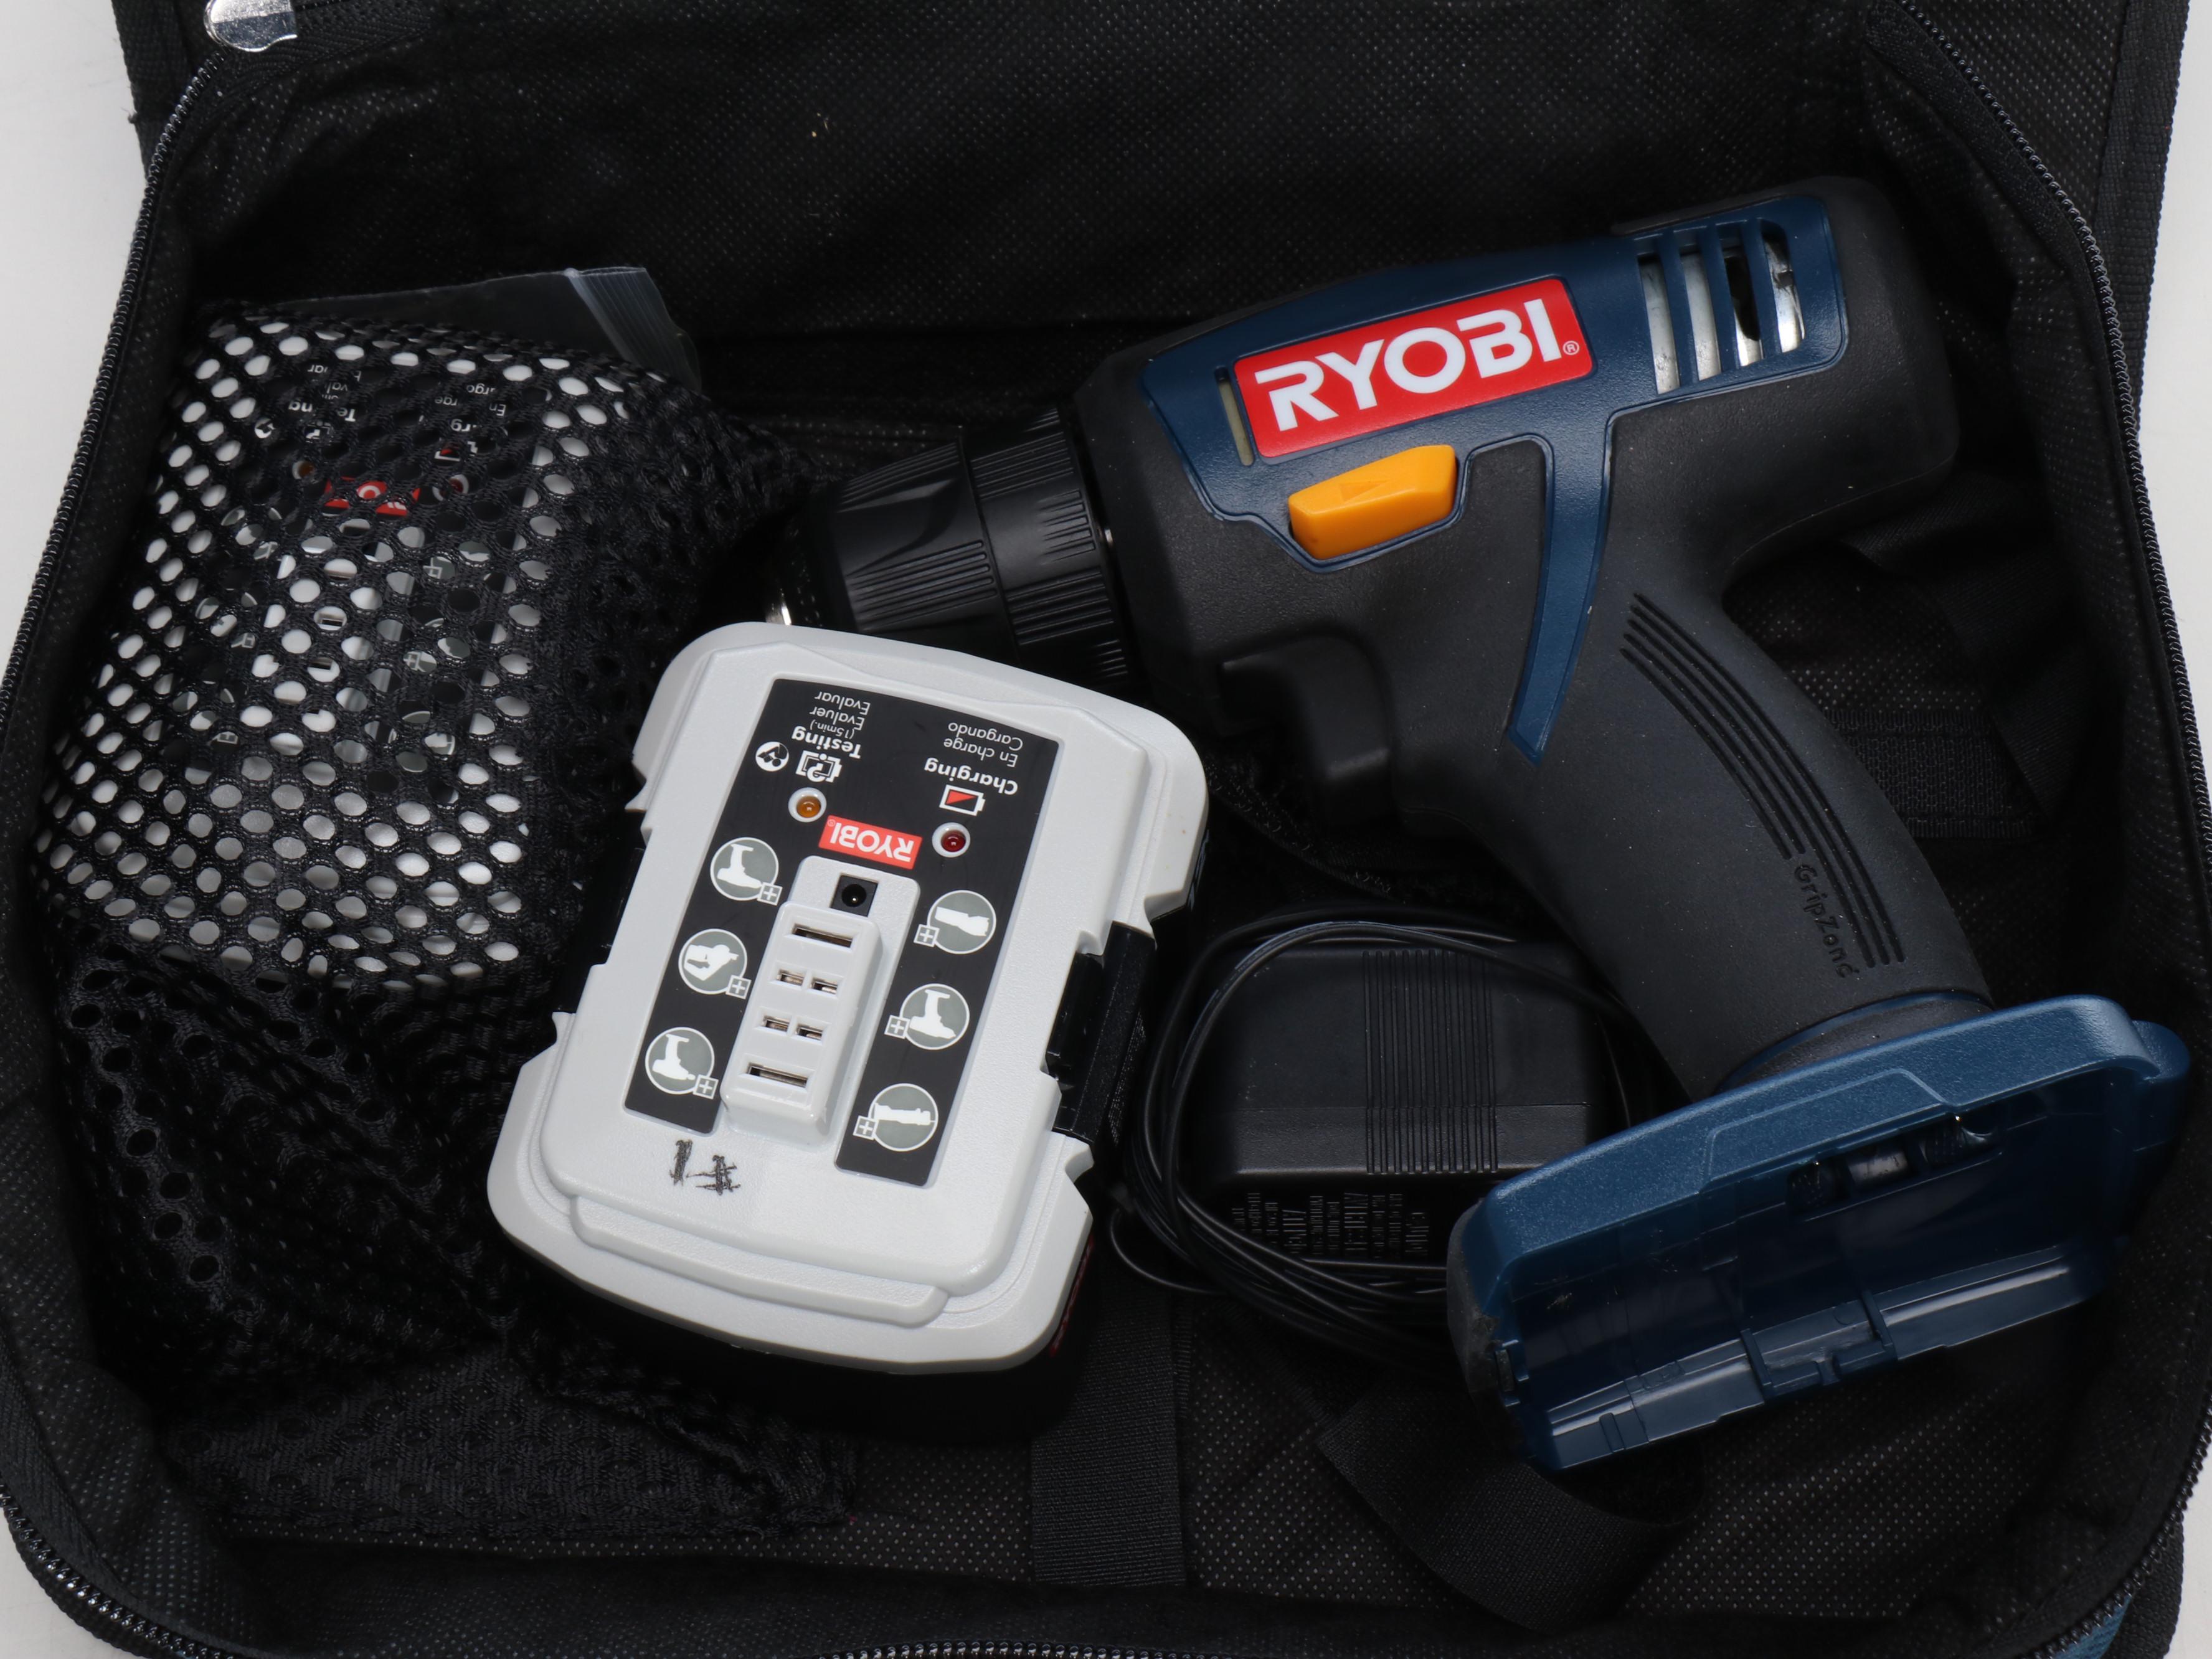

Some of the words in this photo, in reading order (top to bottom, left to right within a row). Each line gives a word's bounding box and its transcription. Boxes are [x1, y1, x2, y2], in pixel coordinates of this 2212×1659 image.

[288, 397, 357, 422] Teng
[814, 691, 871, 715] Evaluar
[810, 706, 866, 730] Evaluer
[810, 720, 855, 740] (15min.)
[791, 726, 862, 759] Testing
[943, 735, 995, 760] charge
[947, 721, 1024, 750] Cargando
[999, 751, 1018, 765] En
[924, 757, 1019, 795] Charging
